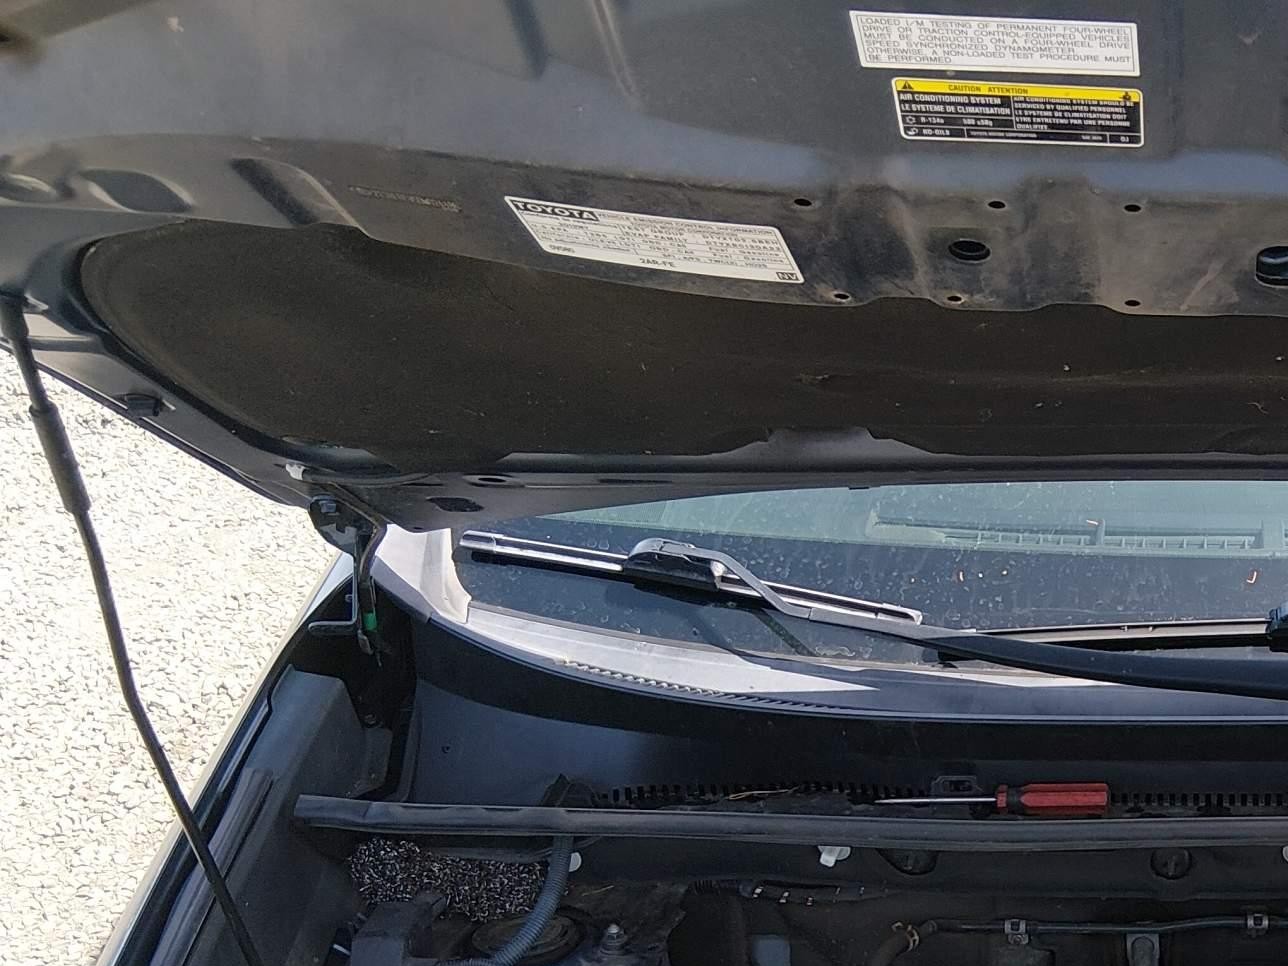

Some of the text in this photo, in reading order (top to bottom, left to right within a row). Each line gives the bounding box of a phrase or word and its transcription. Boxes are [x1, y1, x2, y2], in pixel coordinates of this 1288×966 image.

[861, 18, 1128, 35] LOADED I/M TESTING OF PERMANENT FOUR-WHEEL
[863, 25, 1130, 42] DRIVE OR TRACTION CONTROL-EQUIPPED VEHICLES
[864, 32, 891, 41] MUST
[918, 34, 984, 44] CONDUCTED
[990, 37, 1005, 45] ON
[1025, 38, 1093, 48] FOUR-WHEEL
[1099, 41, 1130, 49] DRIVE
[866, 39, 899, 48] SPEED
[906, 41, 987, 51] SYNCHRONIZED
[943, 49, 1005, 59] NON-LOADED
[1012, 51, 1034, 60] TEST
[1040, 52, 1099, 62] PROCEDURE
[1104, 55, 1132, 63] MUST
[915, 94, 969, 103] CONDITIONING
[911, 104, 944, 112] SYSTEME
[957, 106, 1011, 115] CLIMATISATION
[513, 201, 598, 220] TOYOTA
[778, 272, 798, 281] NV
